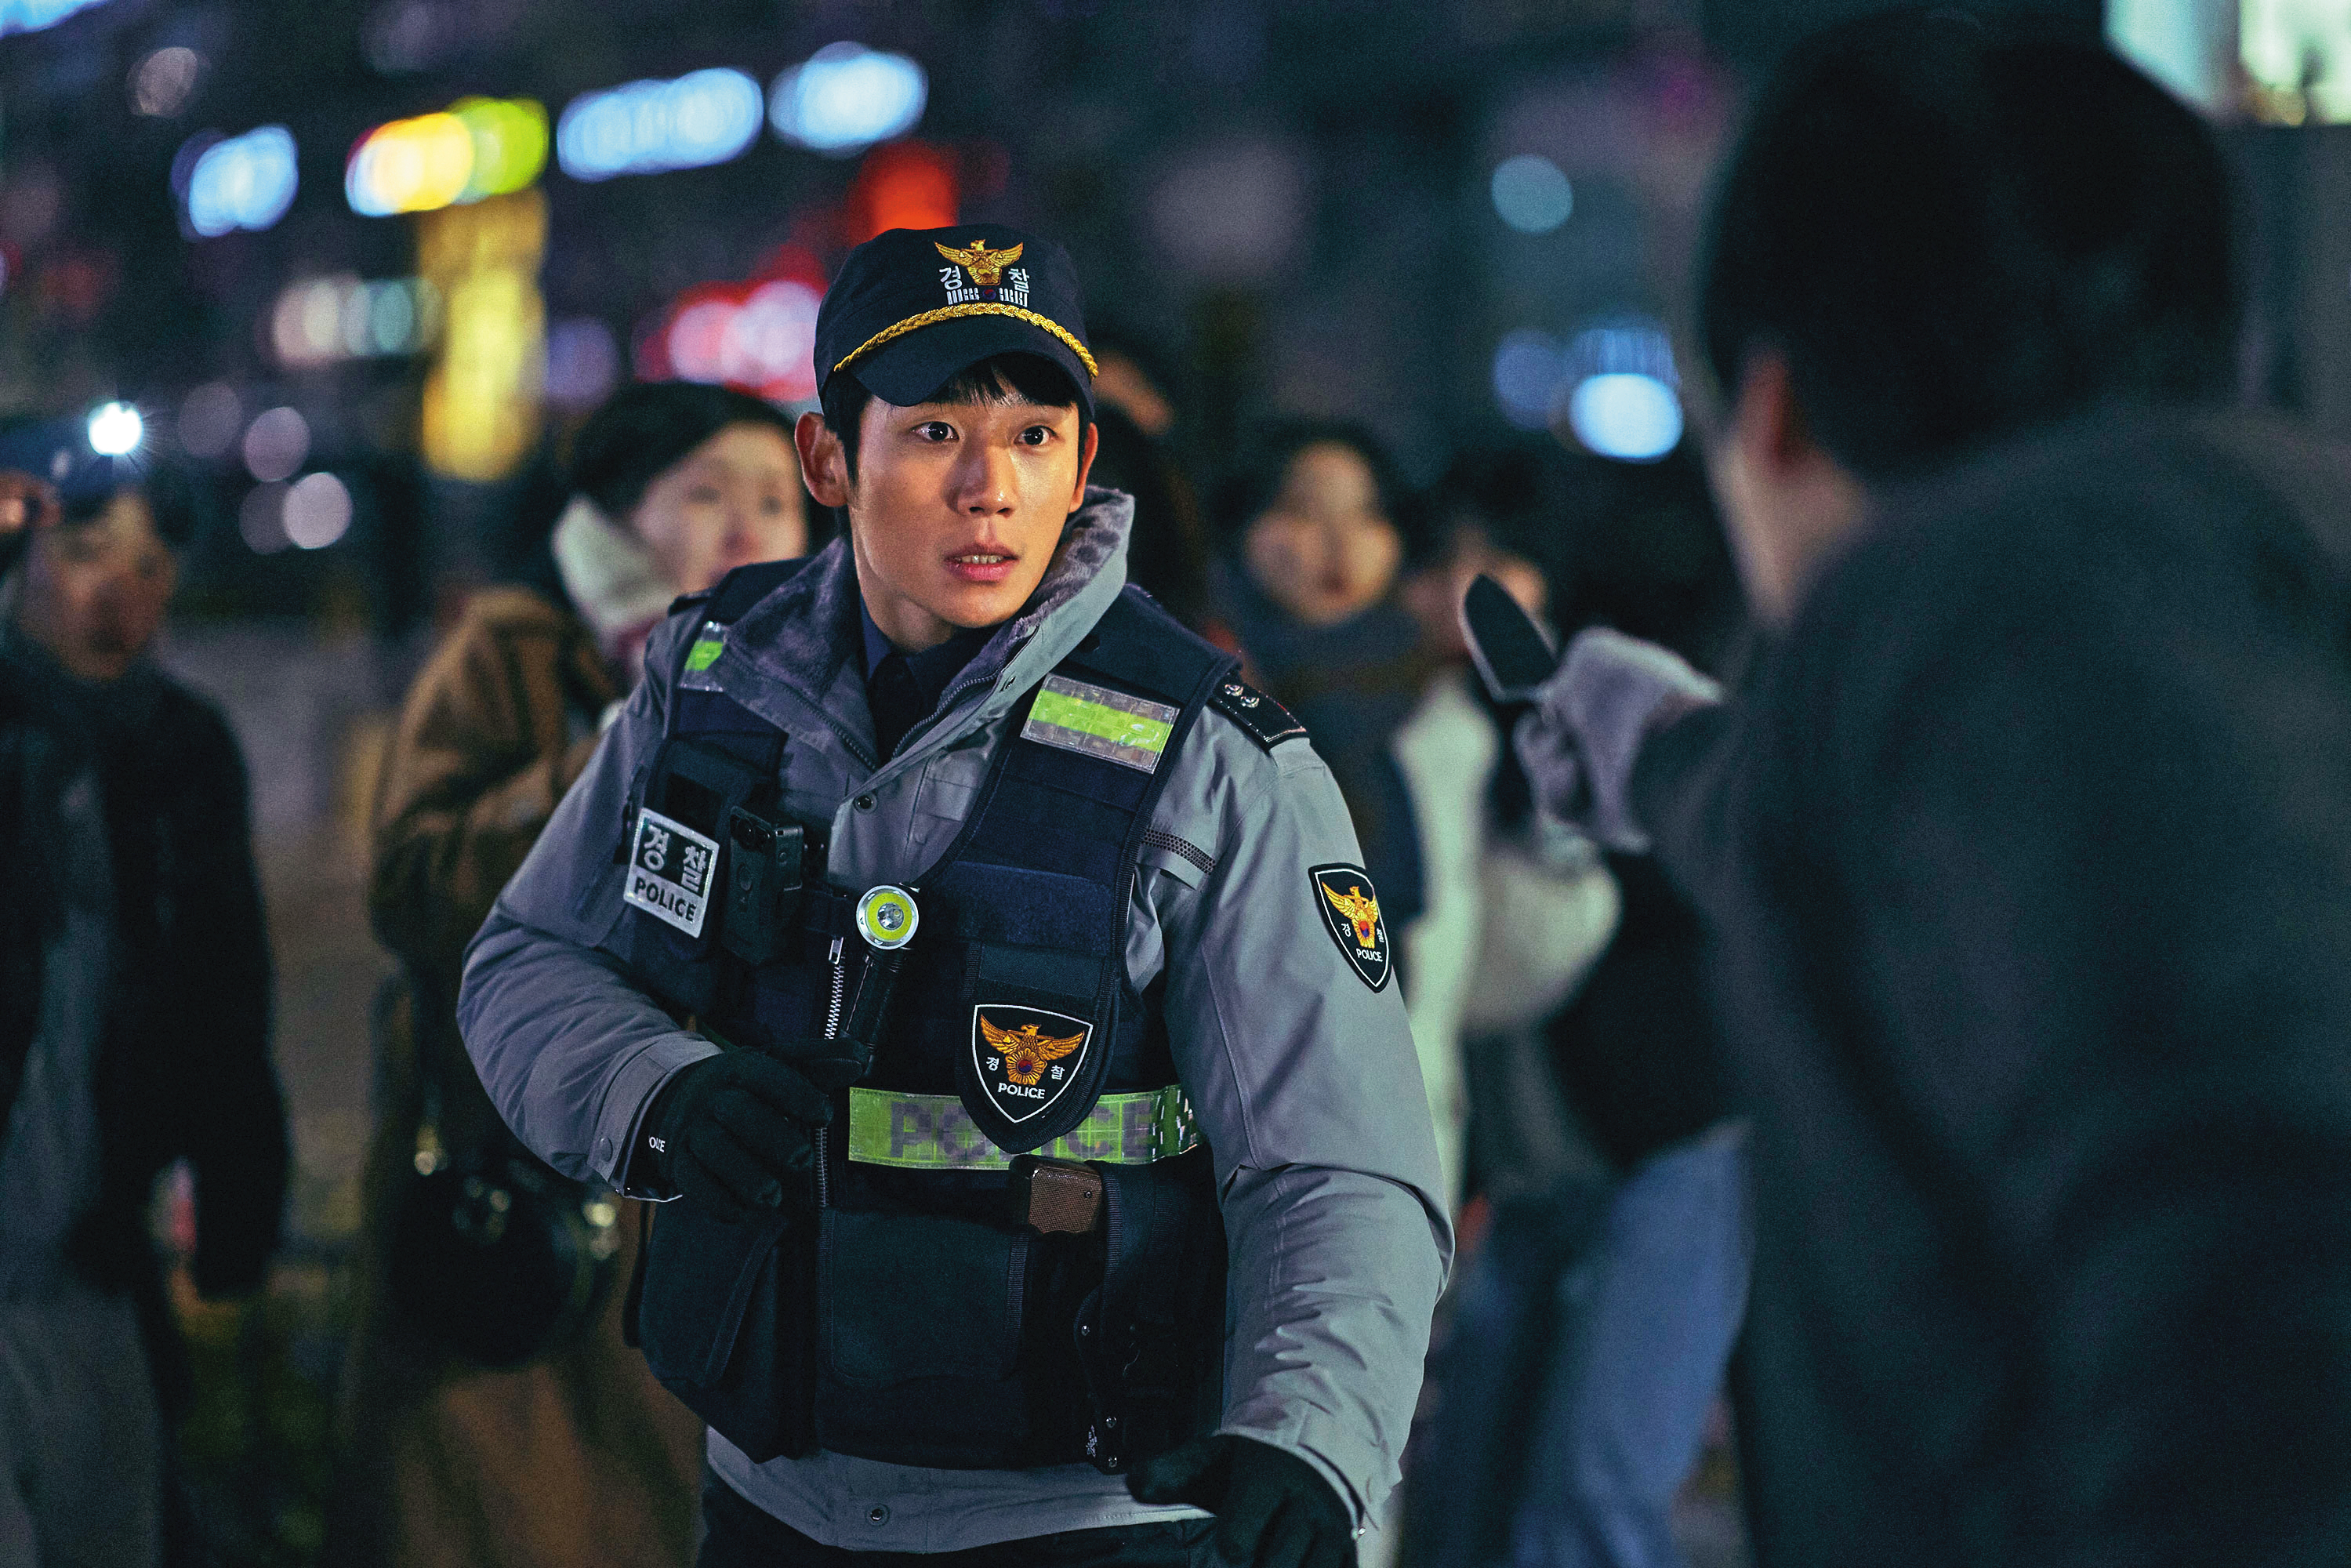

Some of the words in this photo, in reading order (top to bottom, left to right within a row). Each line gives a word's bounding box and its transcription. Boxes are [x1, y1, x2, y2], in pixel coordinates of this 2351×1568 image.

[634, 876, 697, 922] POLICE
[1355, 948, 1384, 962] POLICE
[997, 1082, 1046, 1099] POLICE
[890, 1101, 1152, 1160] POCE
